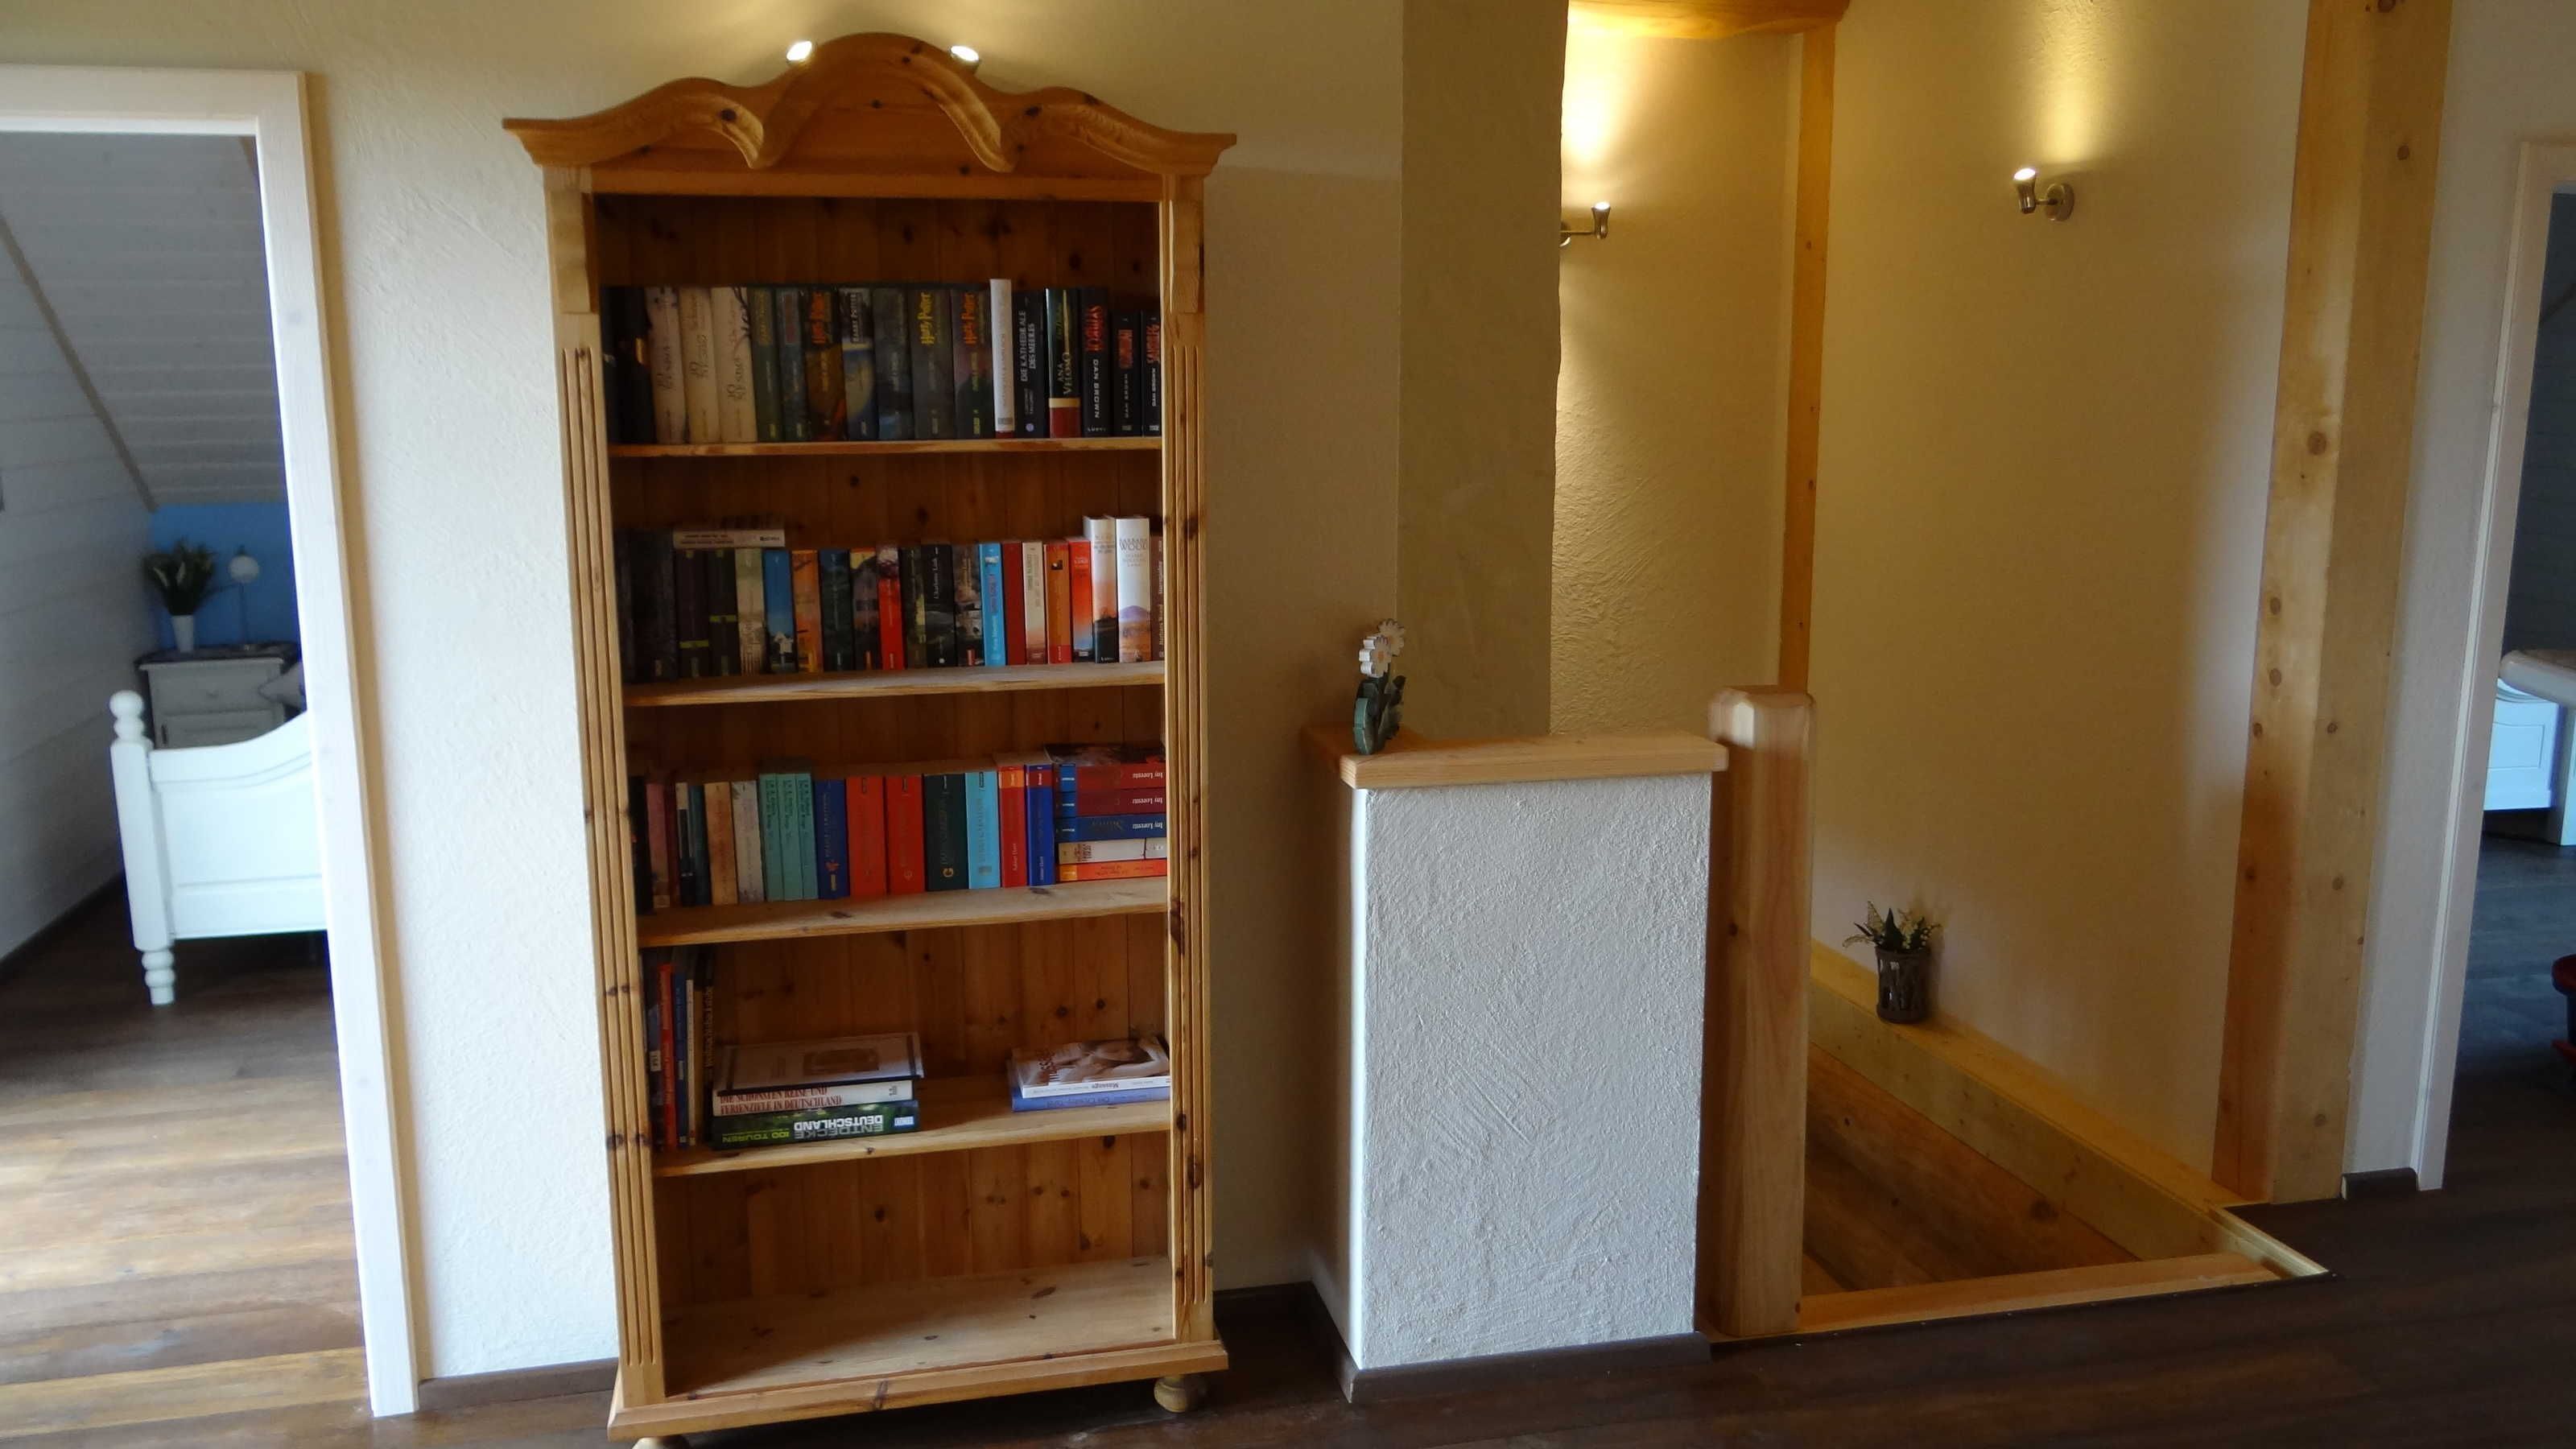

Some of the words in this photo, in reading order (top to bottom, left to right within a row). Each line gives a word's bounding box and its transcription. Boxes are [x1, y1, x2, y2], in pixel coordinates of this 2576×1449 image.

[794, 1114, 884, 1131] DEUTSCHLAND
[721, 1133, 768, 1143] TOUREN
[794, 1124, 884, 1140] ENTDECKE
